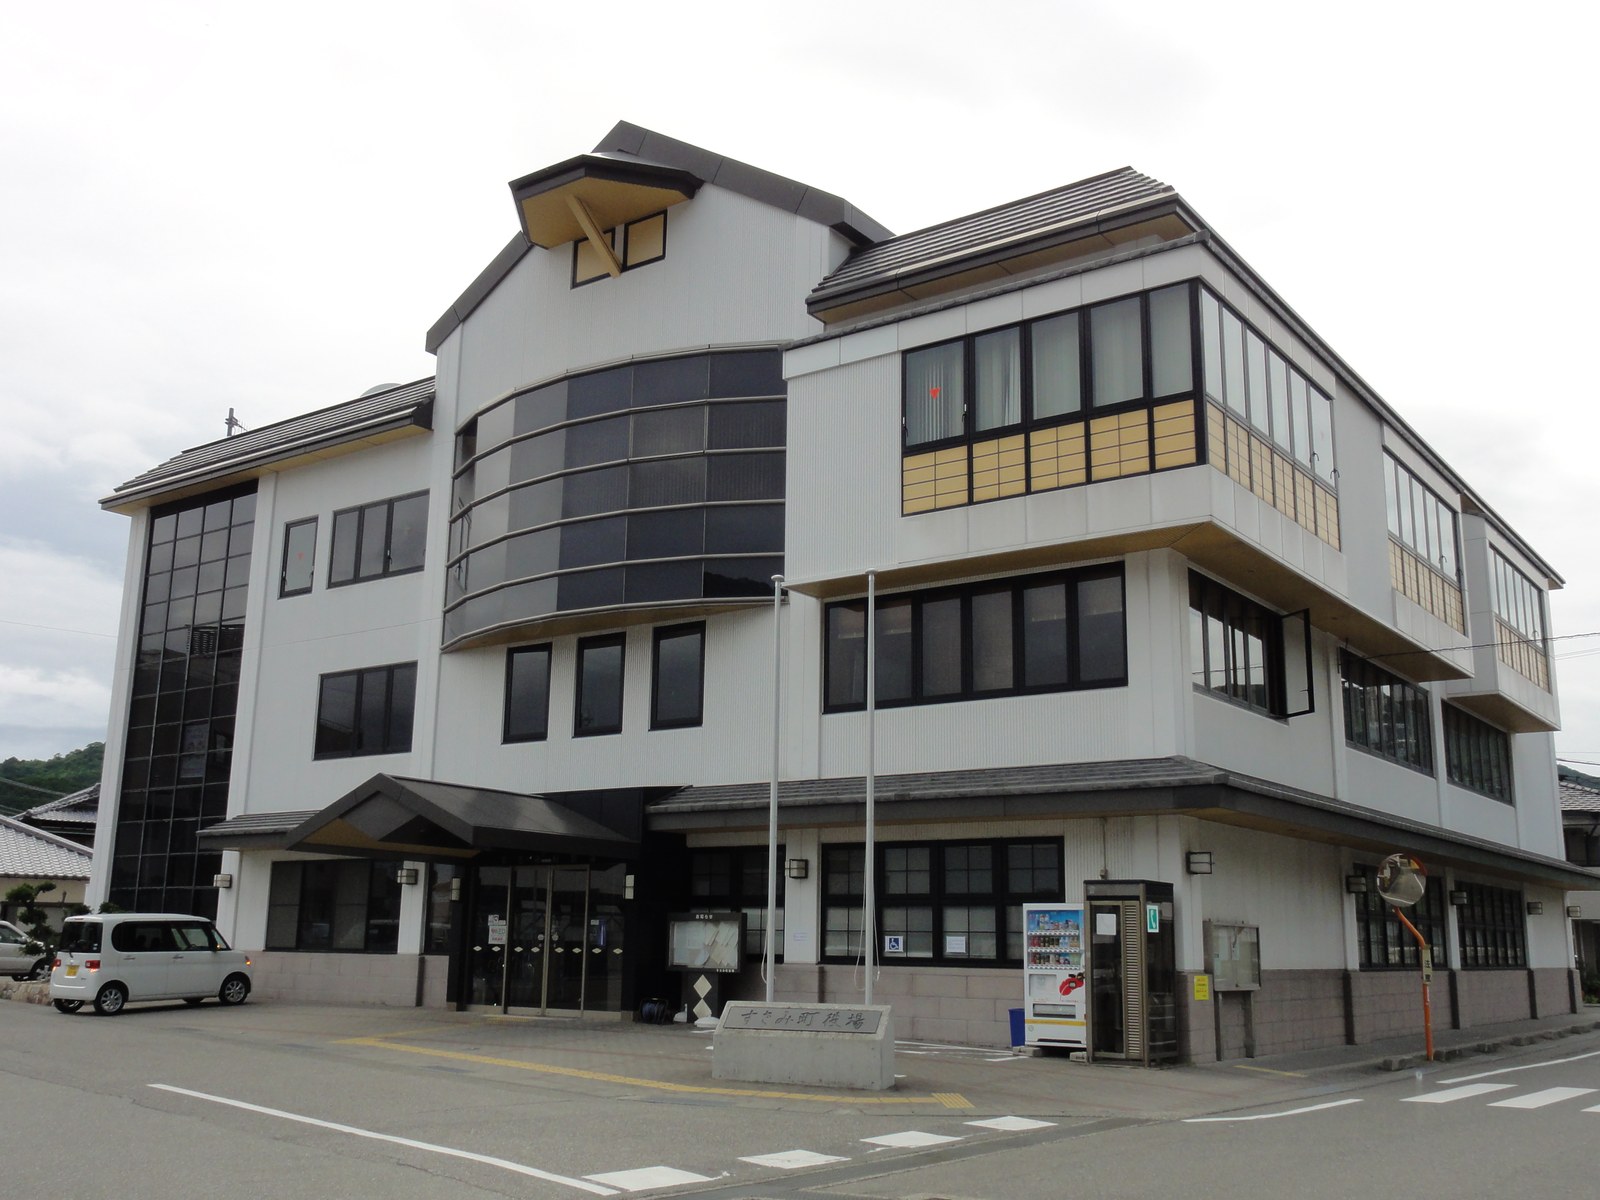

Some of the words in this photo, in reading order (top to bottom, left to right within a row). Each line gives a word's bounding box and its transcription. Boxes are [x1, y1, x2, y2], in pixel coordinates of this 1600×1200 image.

[741, 1009, 865, 1030] すさみ町役場
